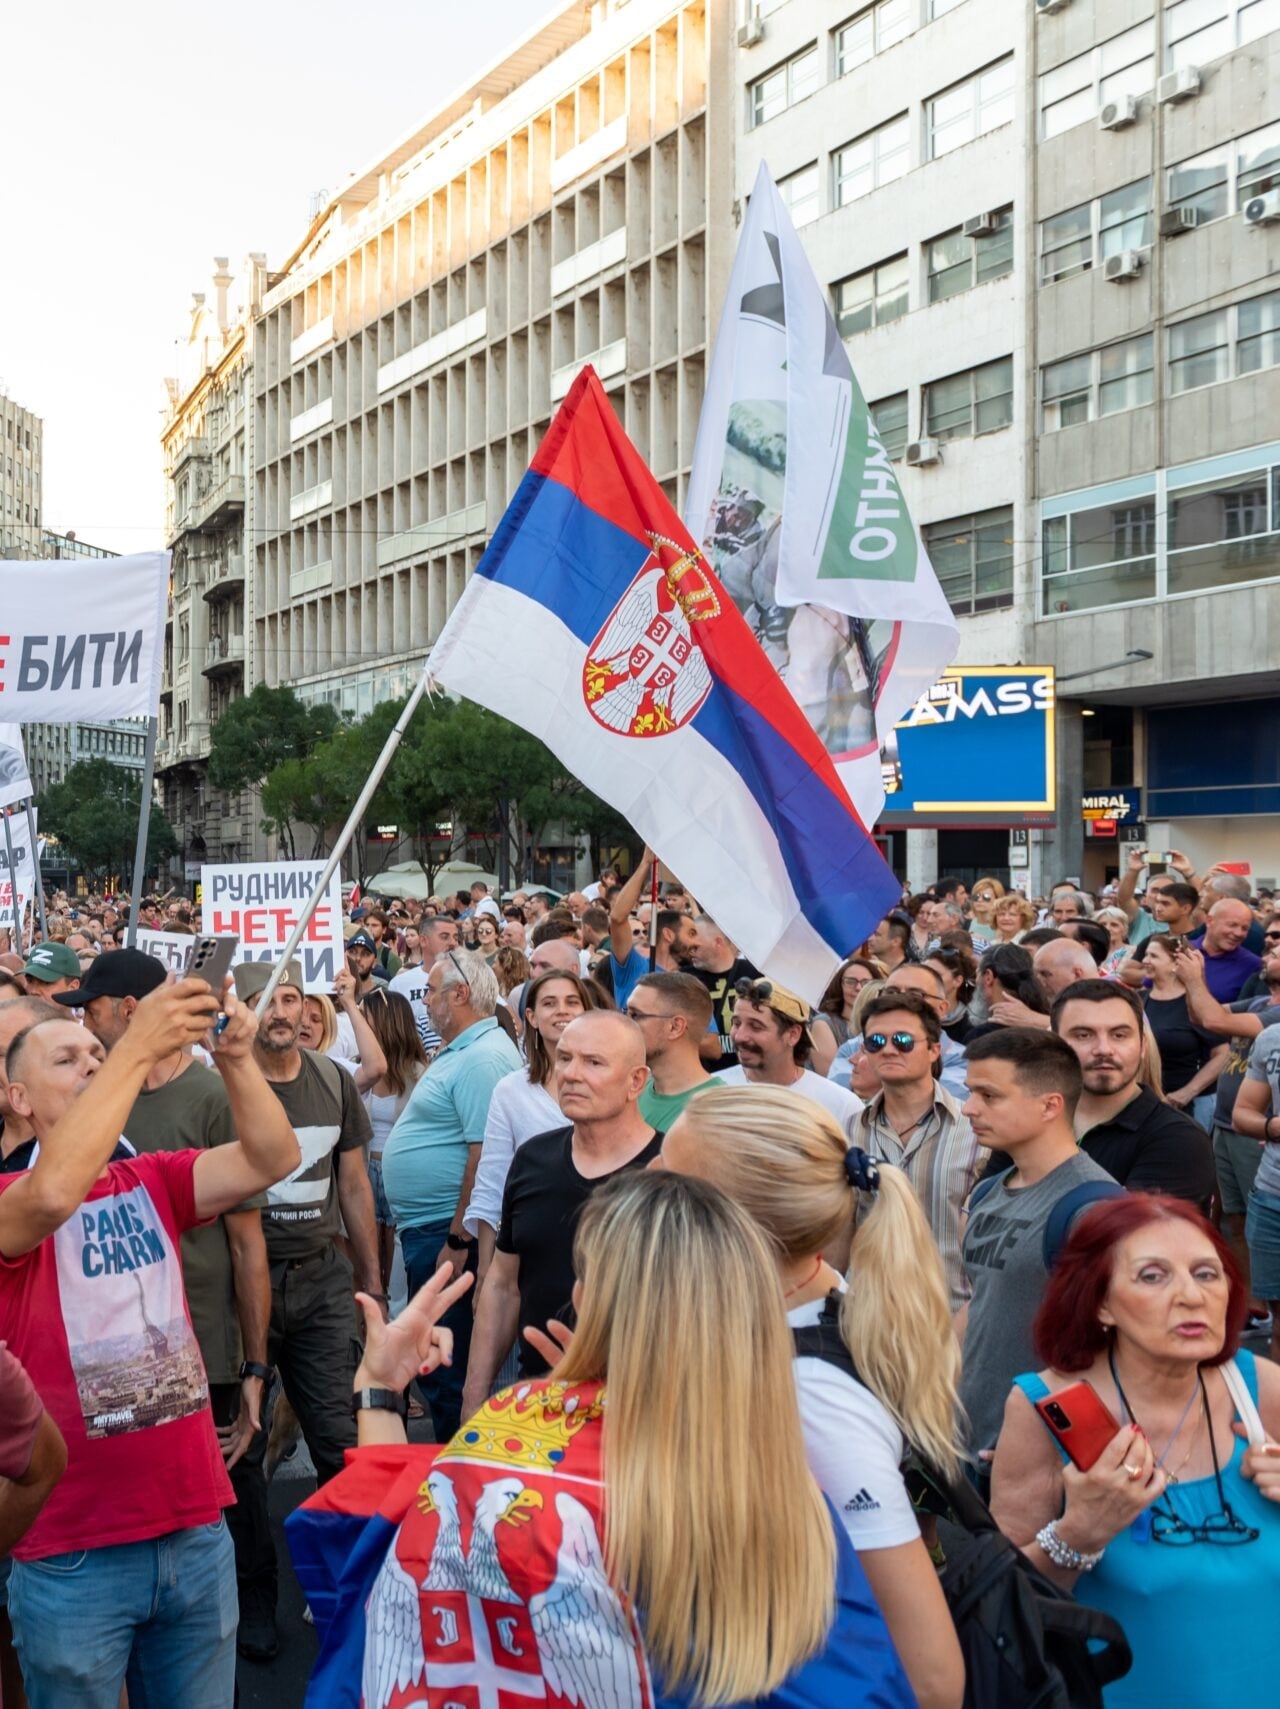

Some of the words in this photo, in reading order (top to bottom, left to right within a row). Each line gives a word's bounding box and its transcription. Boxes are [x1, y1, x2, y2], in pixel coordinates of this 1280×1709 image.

[16, 629, 144, 692] БИТИ
[1015, 830, 1027, 843] 13
[1127, 829, 1139, 841] 13
[32, 948, 54, 964] Z
[81, 1203, 144, 1242] PARIS
[82, 1228, 166, 1278] CHARM
